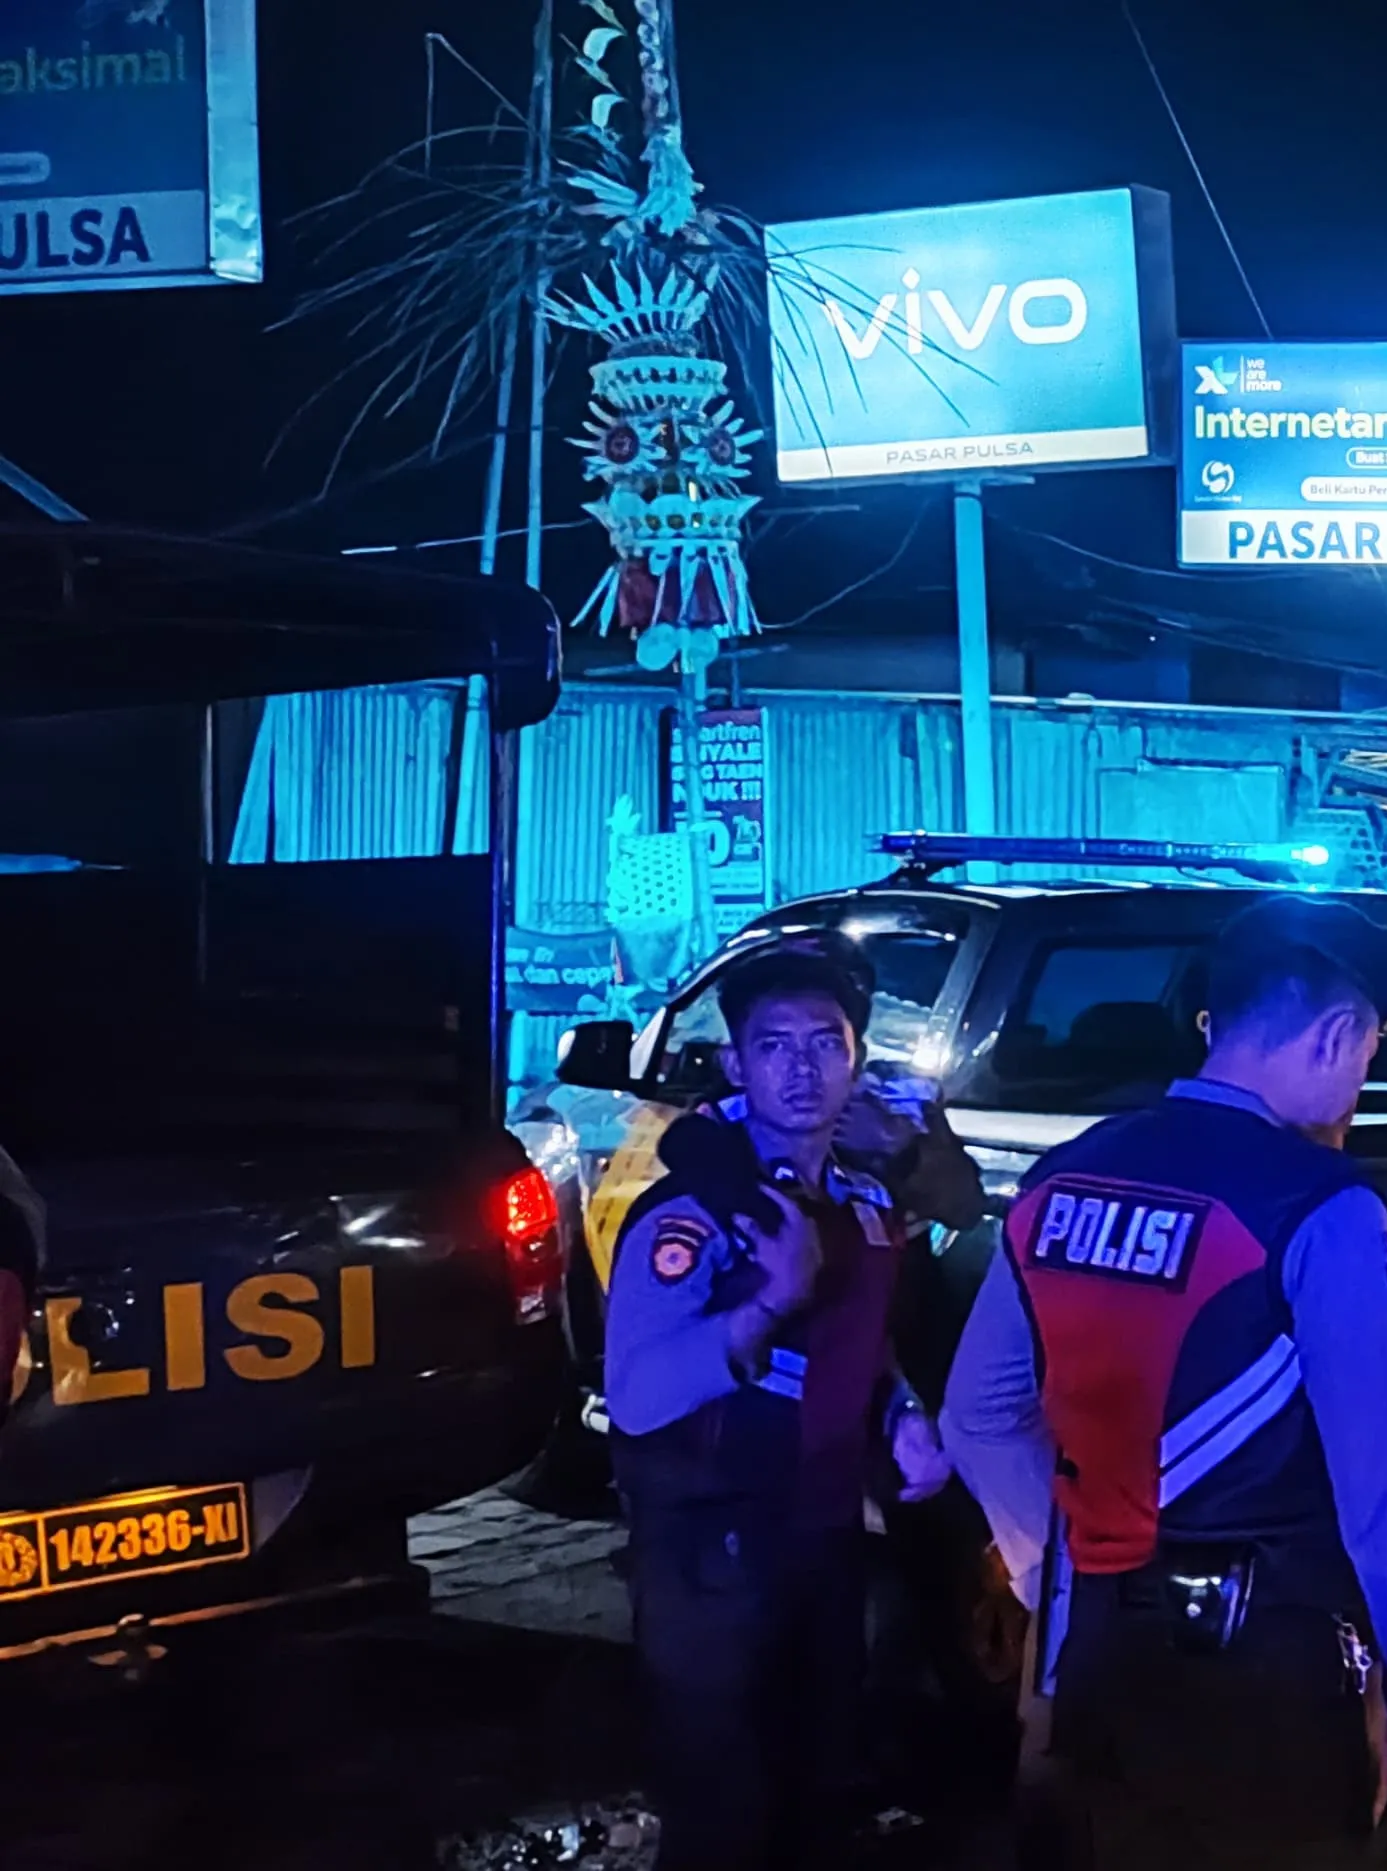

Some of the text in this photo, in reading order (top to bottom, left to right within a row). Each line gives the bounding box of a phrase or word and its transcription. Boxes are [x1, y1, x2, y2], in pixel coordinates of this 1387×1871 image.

[823, 266, 1088, 361] vivo
[1246, 358, 1265, 369] we
[1246, 369, 1267, 380] are
[1246, 380, 1282, 392] more
[885, 440, 1034, 466] PASAR PULSA
[1310, 484, 1332, 495] Beli
[1334, 484, 1366, 495] Kartu
[1228, 520, 1381, 560] PASAR
[672, 722, 761, 743] sartfren
[1034, 1193, 1195, 1279] POLISI
[45, 1265, 377, 1406] LISI
[49, 1501, 238, 1572] 142336-XI
